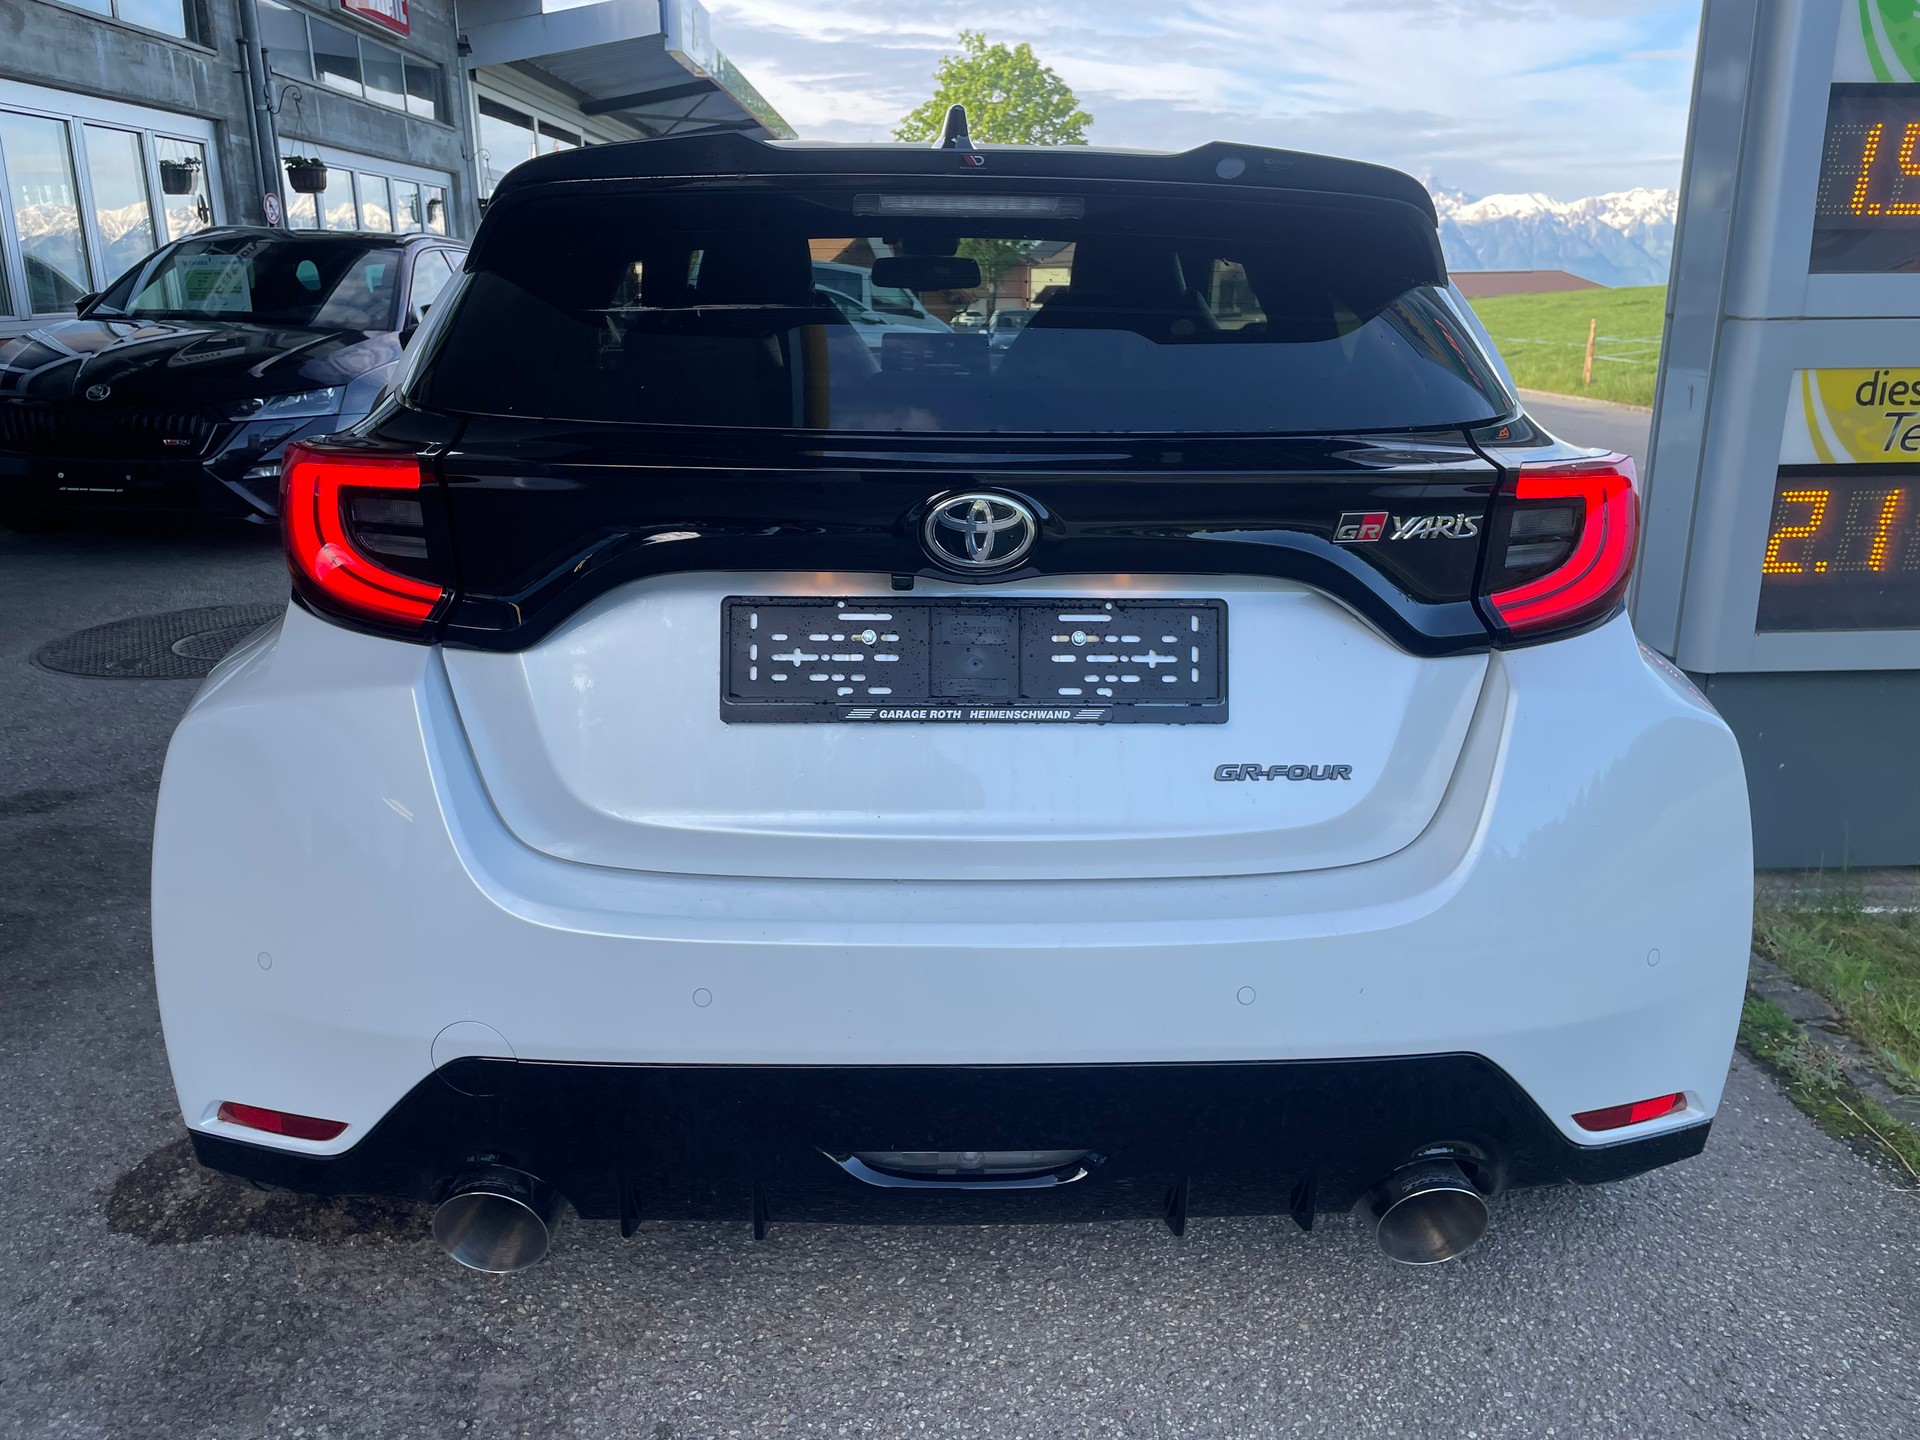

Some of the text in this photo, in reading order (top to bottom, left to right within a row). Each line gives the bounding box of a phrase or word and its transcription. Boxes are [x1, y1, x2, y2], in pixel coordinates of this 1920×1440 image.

[1883, 411, 1920, 452] Te
[1336, 523, 1382, 540] GR
[878, 709, 1072, 721] GARAGE ROTH HEIMENSCHWAND
[1213, 762, 1353, 782] GR-FOUR
